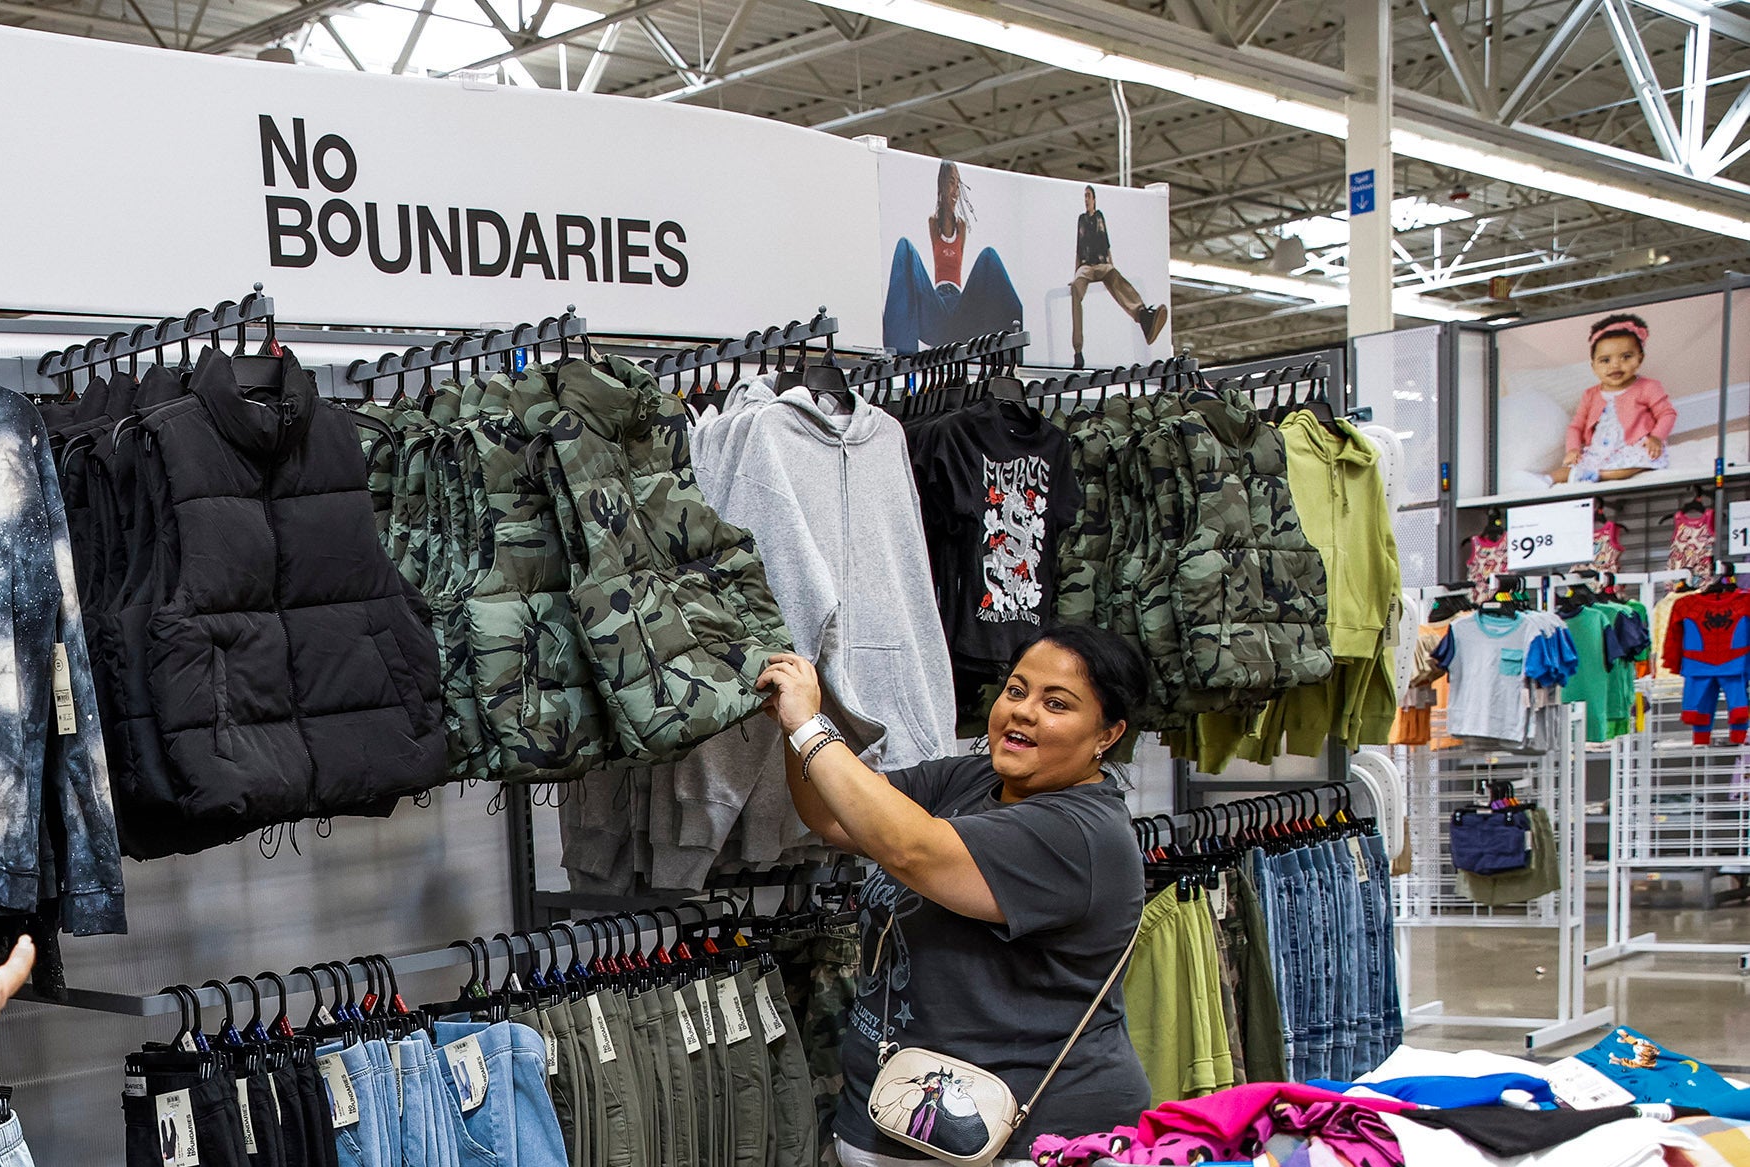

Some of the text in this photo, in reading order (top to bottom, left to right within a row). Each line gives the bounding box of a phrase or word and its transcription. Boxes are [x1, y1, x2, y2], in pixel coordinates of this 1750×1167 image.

[265, 195, 689, 288] BOUNDARIES
[517, 359, 522, 368] 2
[982, 453, 1050, 493] FIERCE
